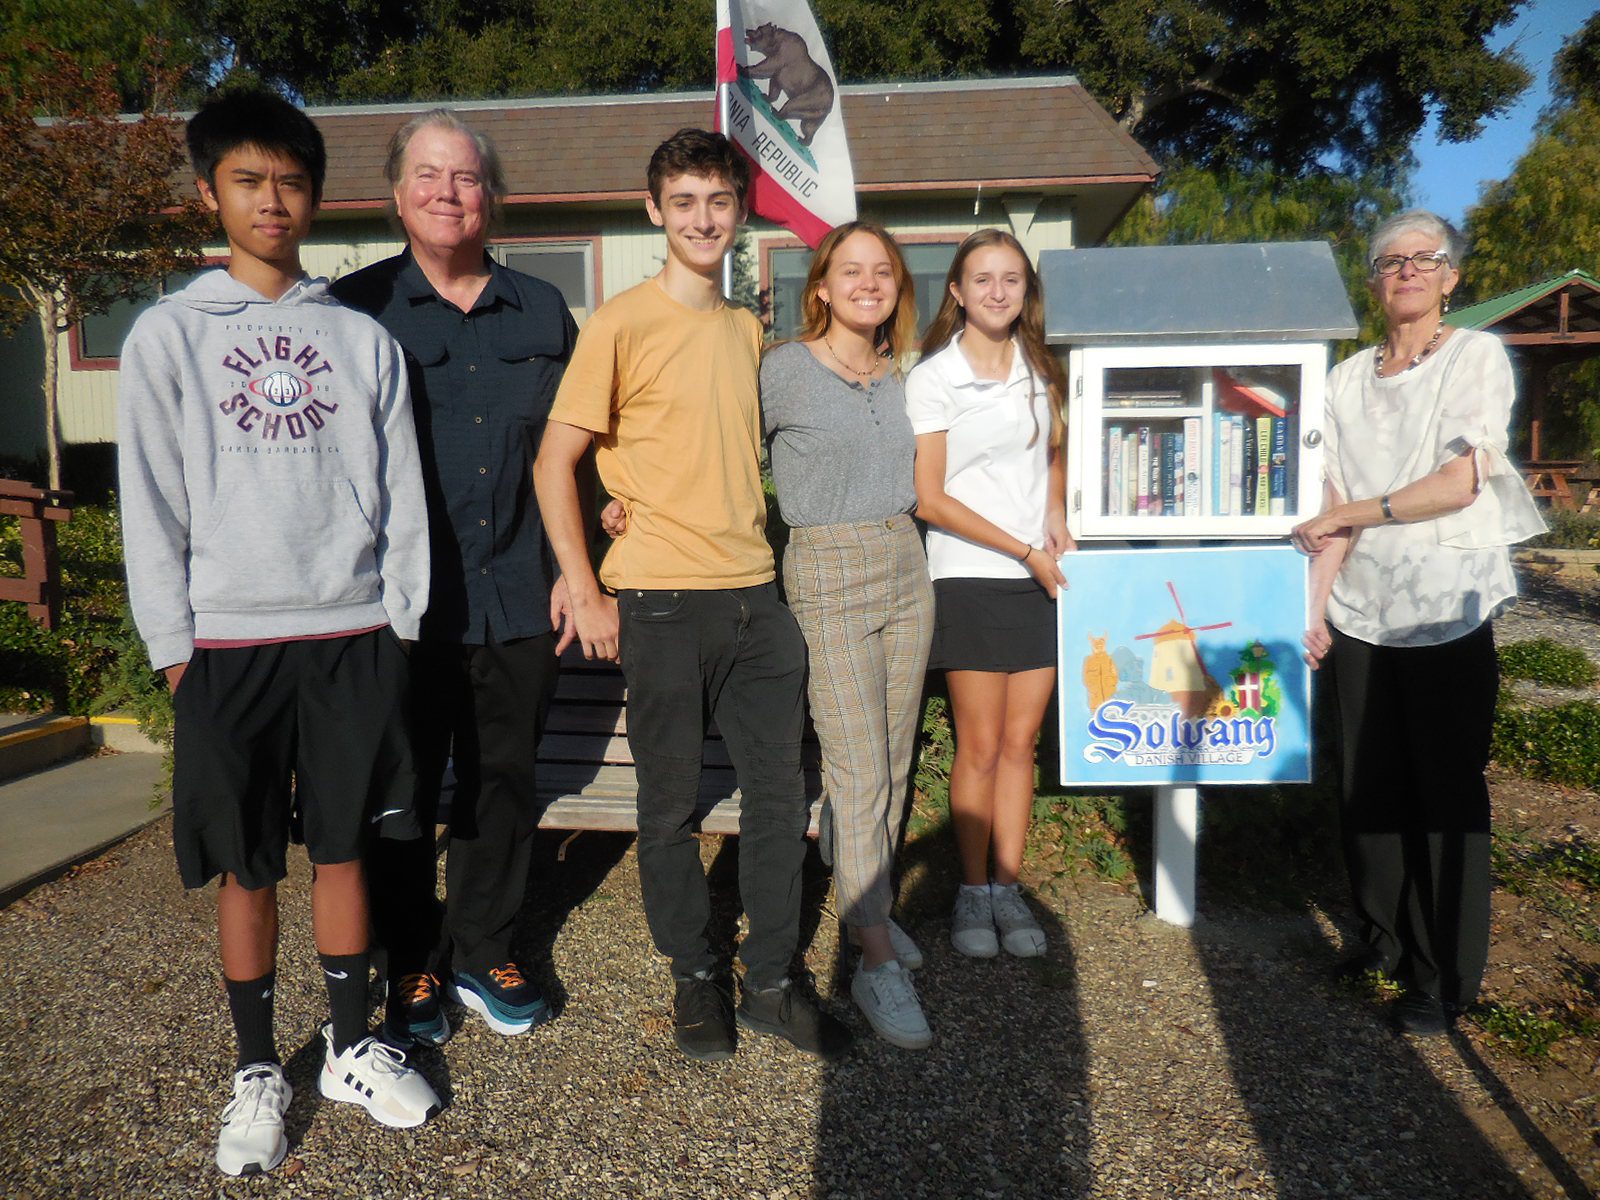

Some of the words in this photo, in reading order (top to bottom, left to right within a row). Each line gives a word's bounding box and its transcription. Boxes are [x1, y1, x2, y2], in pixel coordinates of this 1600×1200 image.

[751, 131, 819, 198] REPUBLIC
[222, 335, 333, 377] FLIGHT
[219, 392, 339, 440] SCHOOL
[220, 445, 258, 454] SANTA
[1085, 700, 1277, 761] Solvang
[1135, 754, 1184, 765] DANISH
[1190, 752, 1244, 763] VILLAGE
